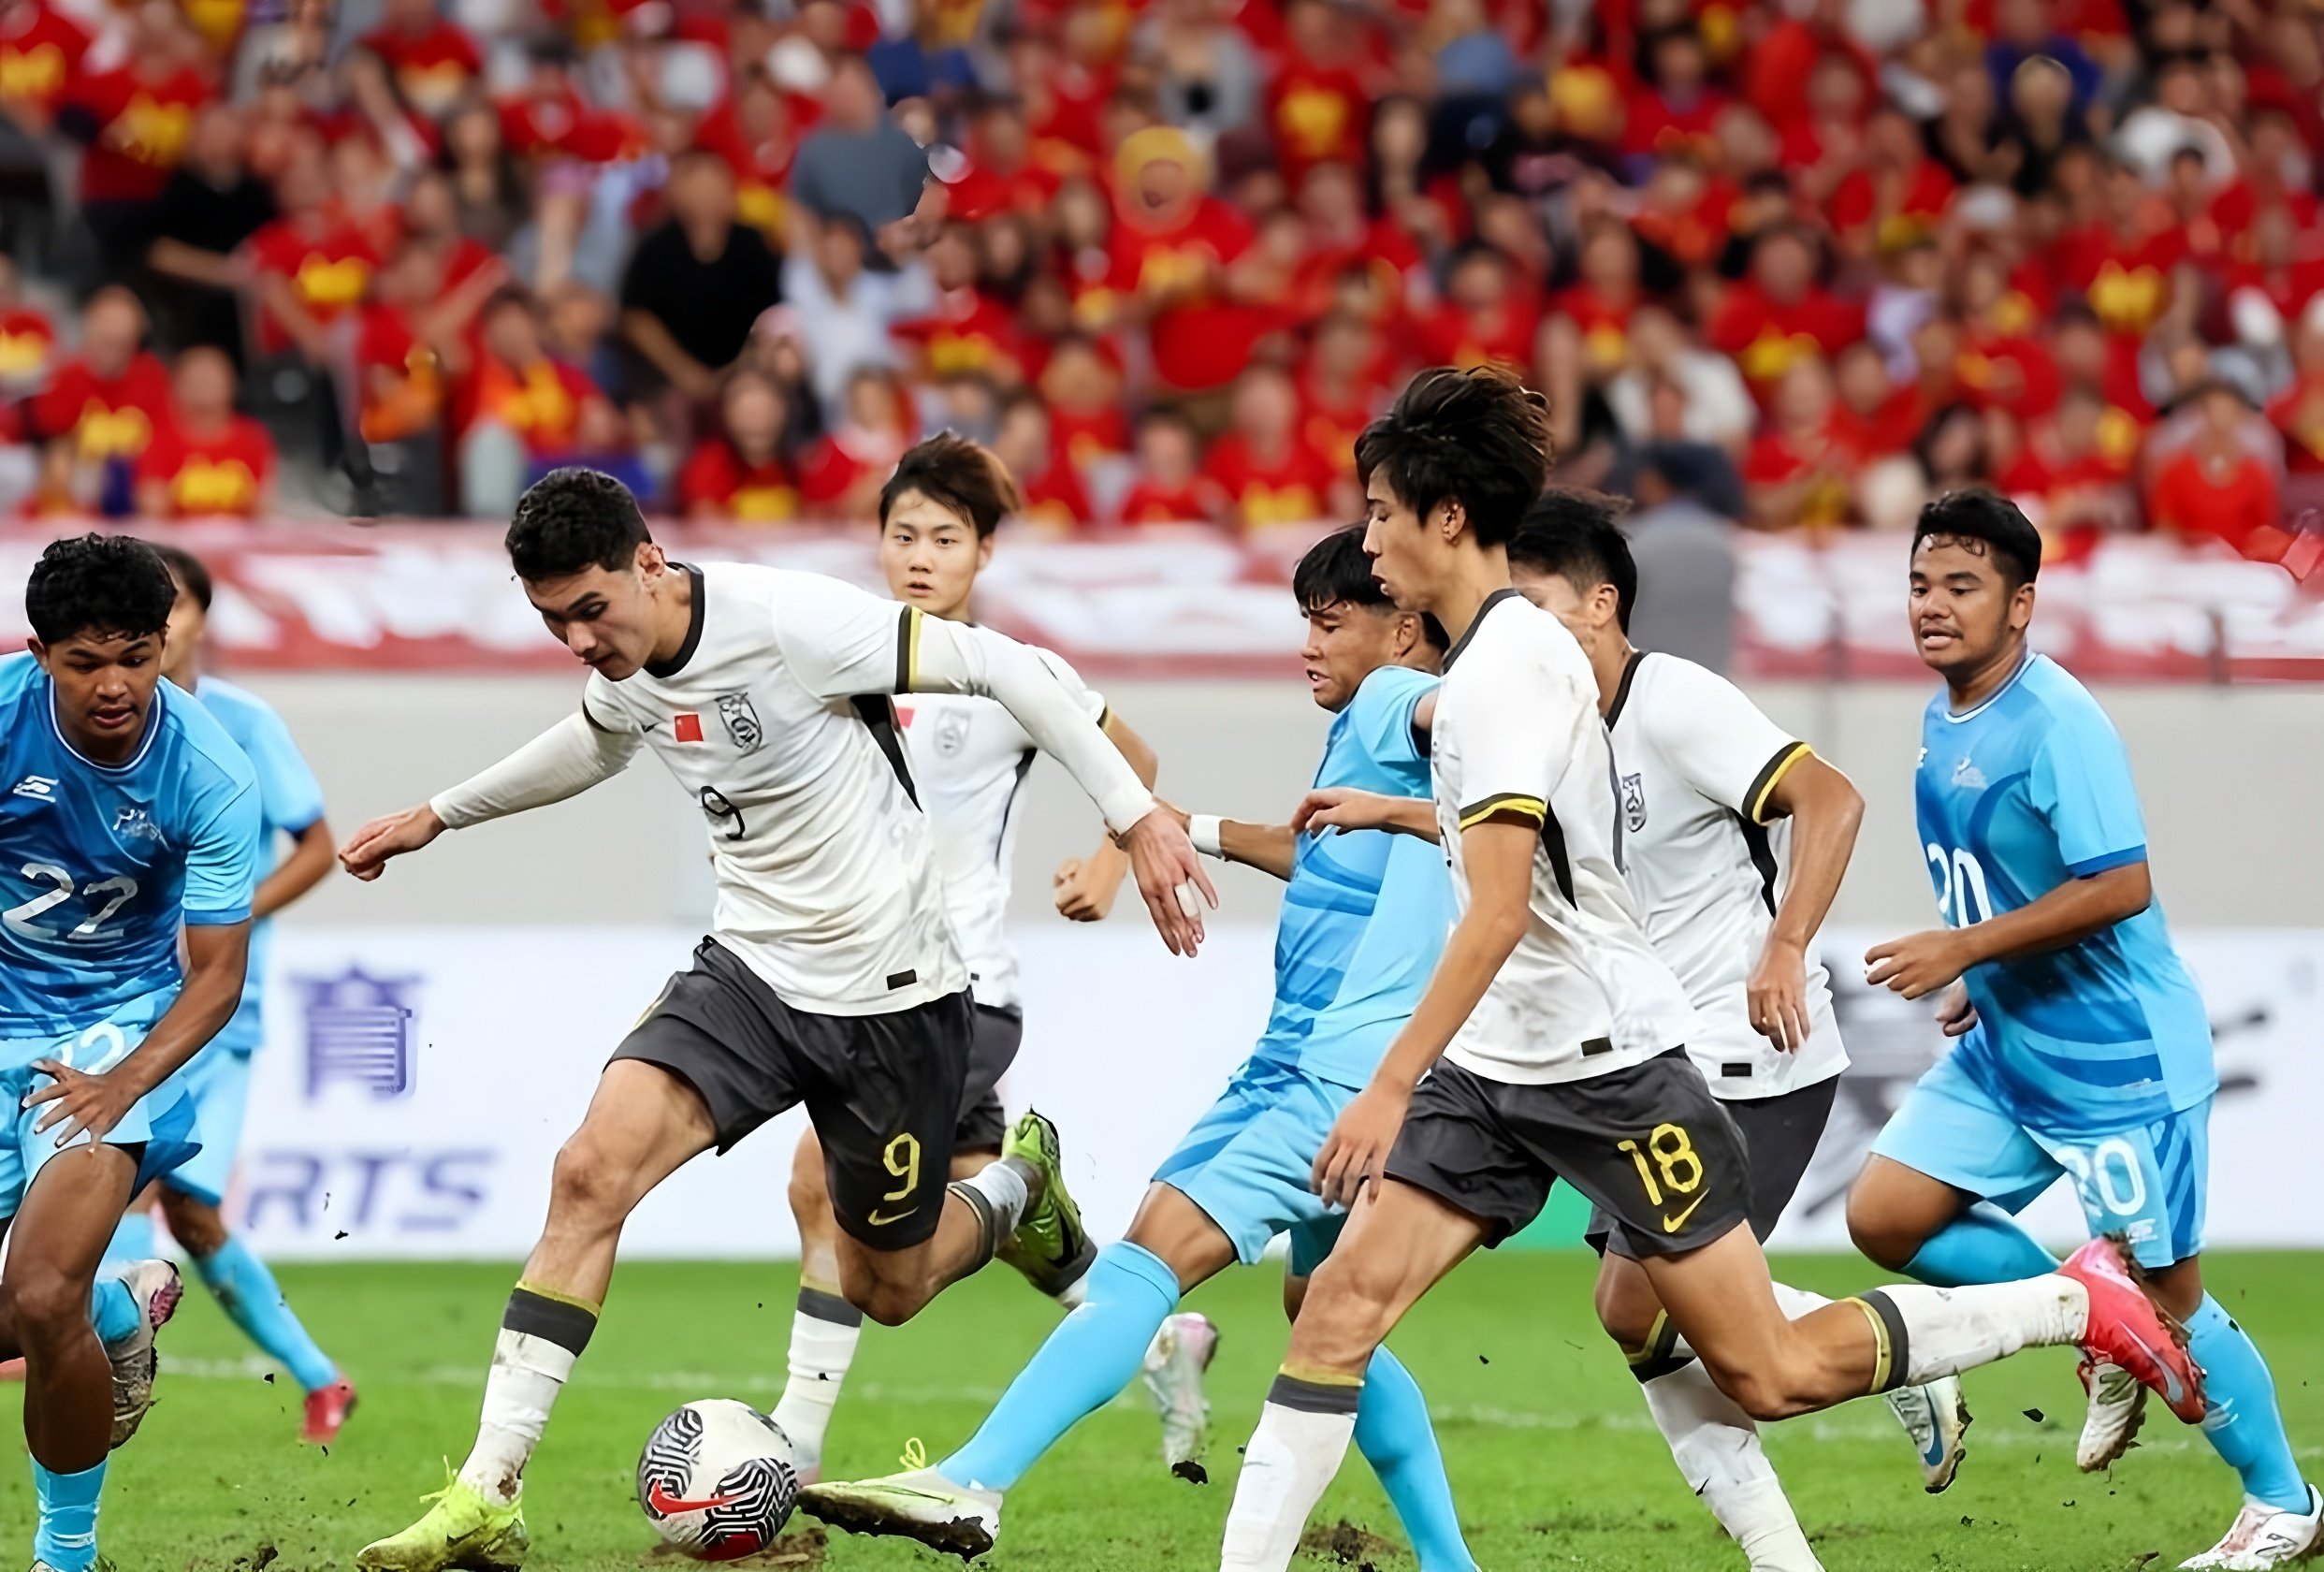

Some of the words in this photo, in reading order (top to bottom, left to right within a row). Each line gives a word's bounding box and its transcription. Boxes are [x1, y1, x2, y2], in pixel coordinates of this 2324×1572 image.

[699, 784, 746, 841] 9
[2, 862, 138, 940] 22
[285, 964, 426, 1100] 育
[245, 1148, 497, 1231] RTS
[882, 1132, 922, 1201] 9
[1617, 1123, 1705, 1206] 18
